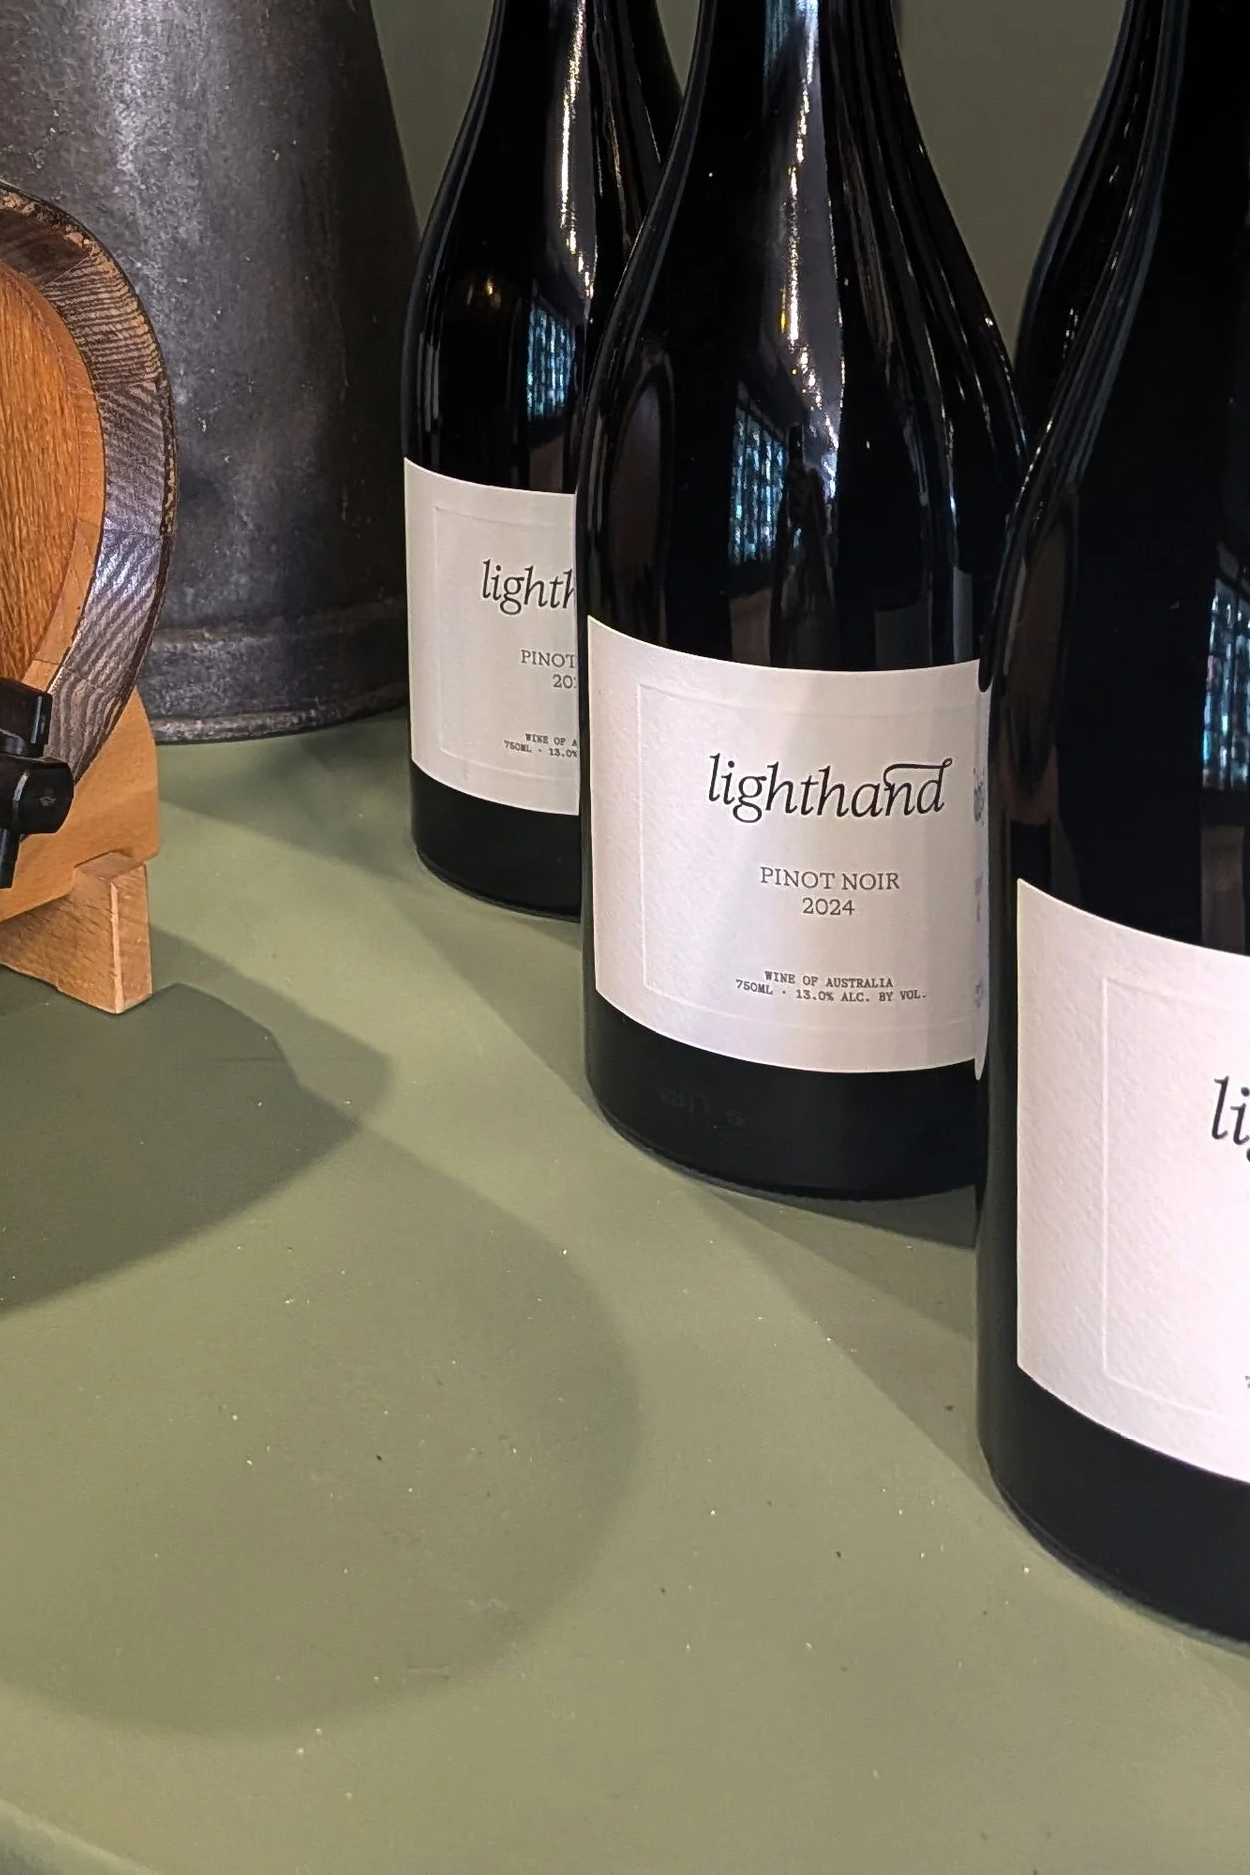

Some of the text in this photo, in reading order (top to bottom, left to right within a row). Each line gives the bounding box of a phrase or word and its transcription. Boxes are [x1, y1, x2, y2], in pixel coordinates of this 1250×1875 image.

[521, 649, 576, 669] PINOT
[553, 674, 577, 689] 20
[503, 740, 532, 753] 750ML
[525, 733, 549, 744] WINE
[554, 736, 566, 746] OF
[708, 753, 953, 824] lighthand
[760, 866, 901, 891] PINOT NOIR
[801, 897, 855, 916] 2024
[764, 970, 894, 989] WINE OF AUSTRALIA
[735, 979, 774, 997] 750ML
[795, 987, 834, 1002] 13.0%
[840, 989, 871, 1003] ALC.
[878, 989, 893, 1002] BY
